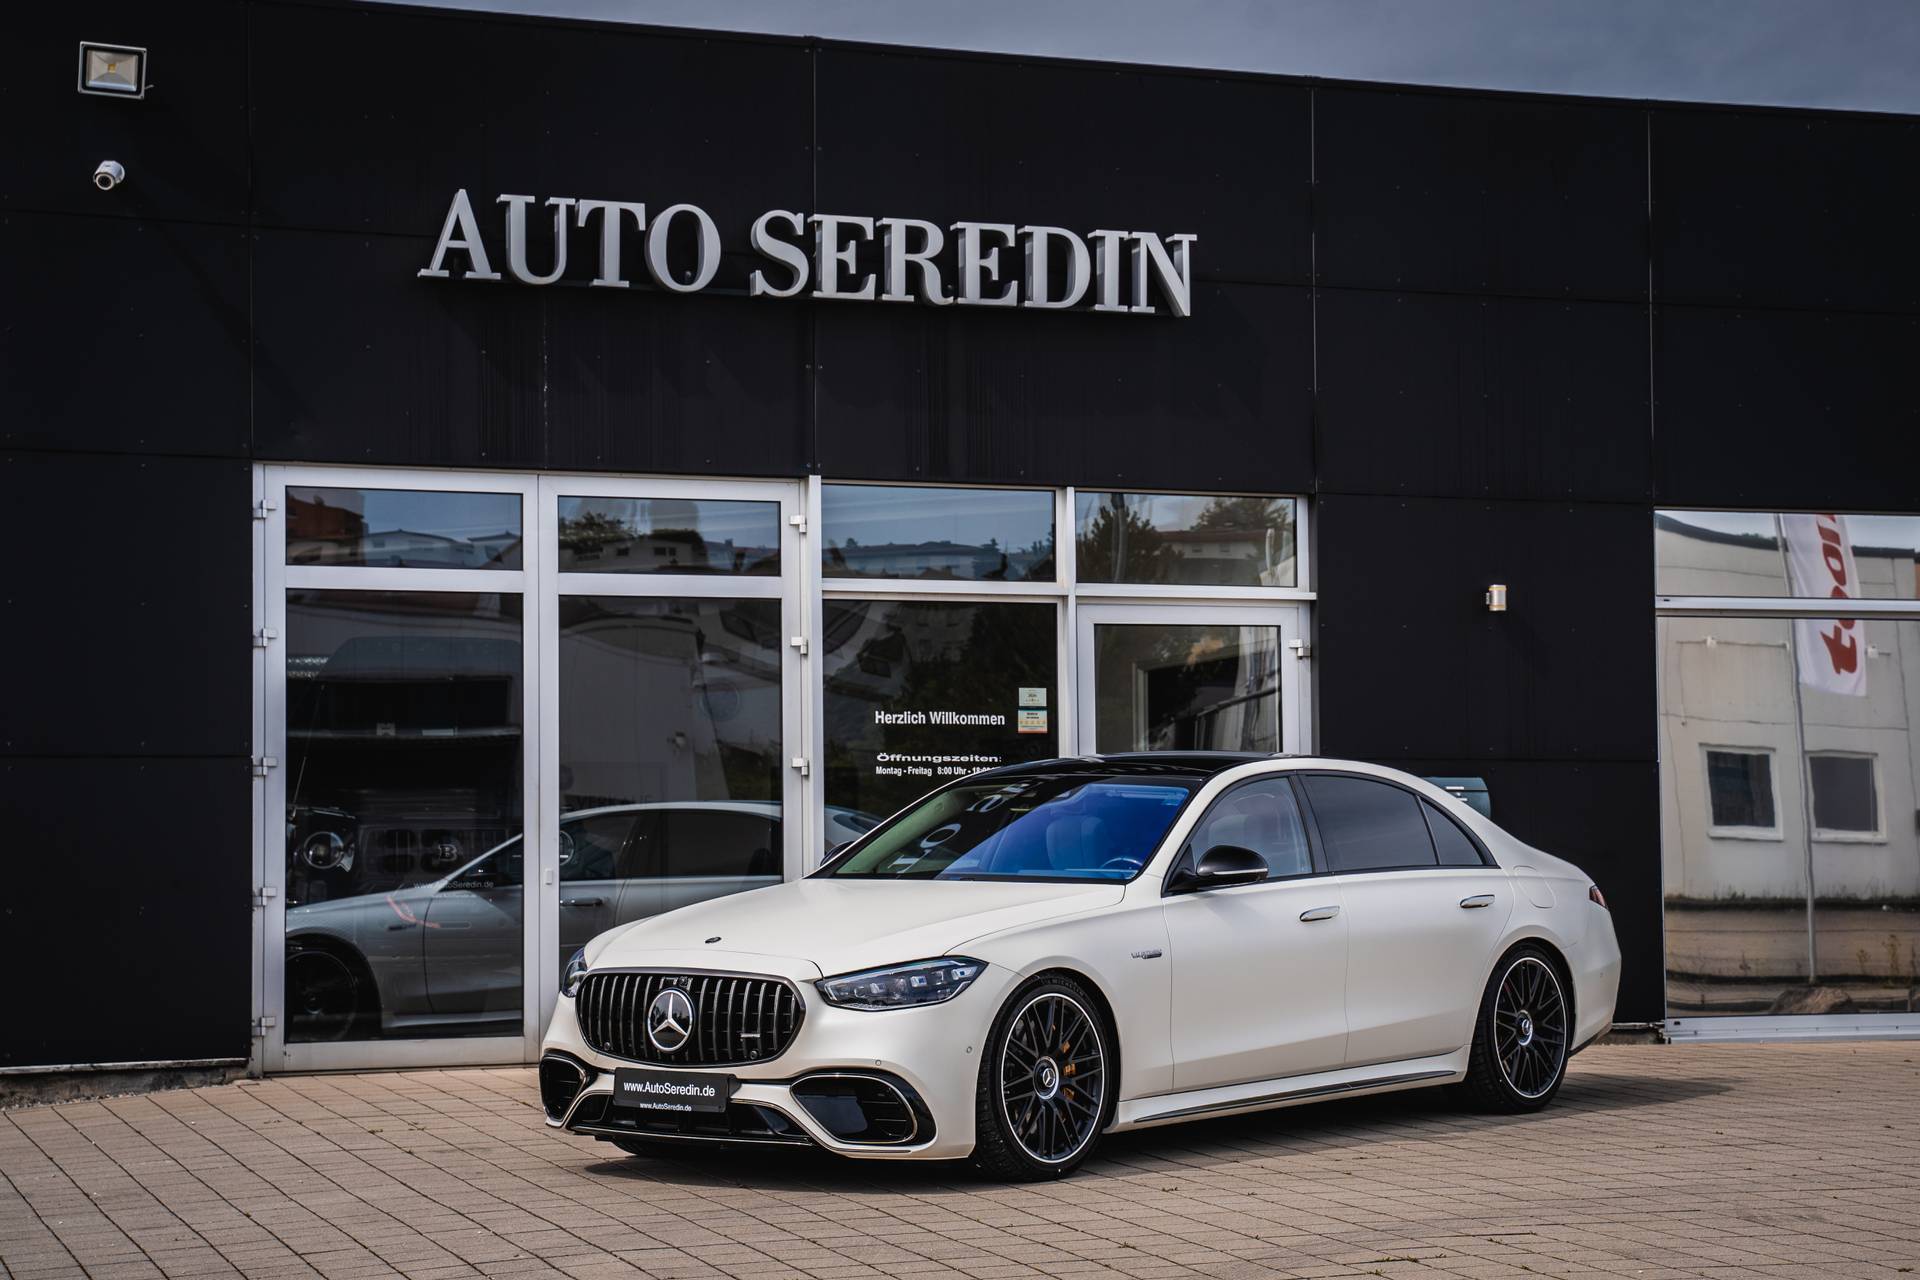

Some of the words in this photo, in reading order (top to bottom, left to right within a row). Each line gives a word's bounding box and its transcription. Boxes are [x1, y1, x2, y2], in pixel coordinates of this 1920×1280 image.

[417, 188, 722, 292] AUTO
[750, 209, 1198, 317] SEREDIN
[874, 710, 927, 725] Herzlich
[928, 710, 1006, 726] Willkommen
[876, 752, 1002, 764] Öffnungszeiten:
[875, 765, 902, 777] Montag
[907, 765, 933, 777] Freitag
[937, 766, 953, 775] 8:00
[953, 766, 966, 775] Uhr
[623, 1081, 716, 1097] www.AutoSeredin.de
[639, 1102, 692, 1112] www.AutoSeredin.de
